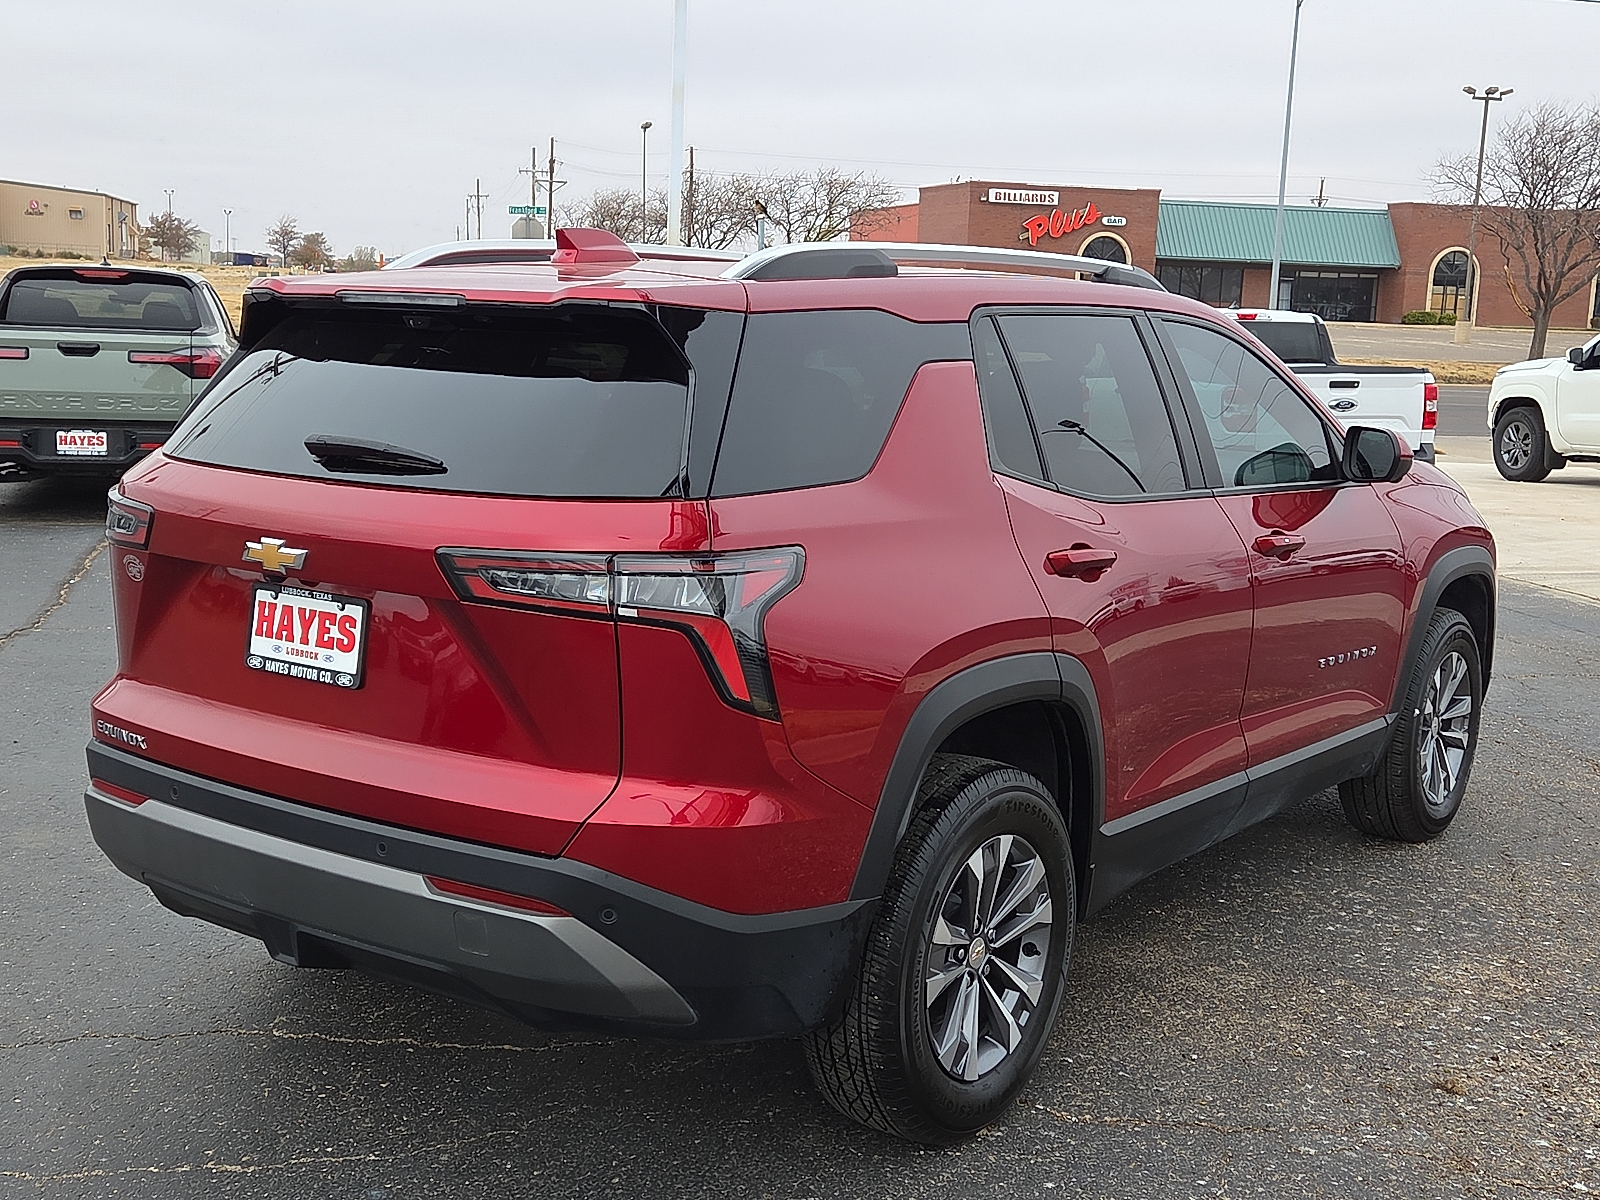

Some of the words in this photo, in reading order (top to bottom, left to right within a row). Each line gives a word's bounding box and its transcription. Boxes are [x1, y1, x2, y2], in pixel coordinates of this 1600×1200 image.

[994, 191, 1055, 203] BILLIARDS
[1021, 202, 1102, 247] Plus
[95, 394, 180, 411] CRUZ
[58, 435, 105, 446] HAYES
[312, 591, 333, 601] TEXAS
[255, 600, 358, 653] HAYES
[286, 646, 319, 661] LUBBOCK
[1317, 645, 1377, 669] EQUINOX
[265, 660, 289, 675] HAYES
[290, 664, 318, 681] MOTOR
[319, 670, 333, 684] CO.
[97, 719, 148, 750] EQUINOX
